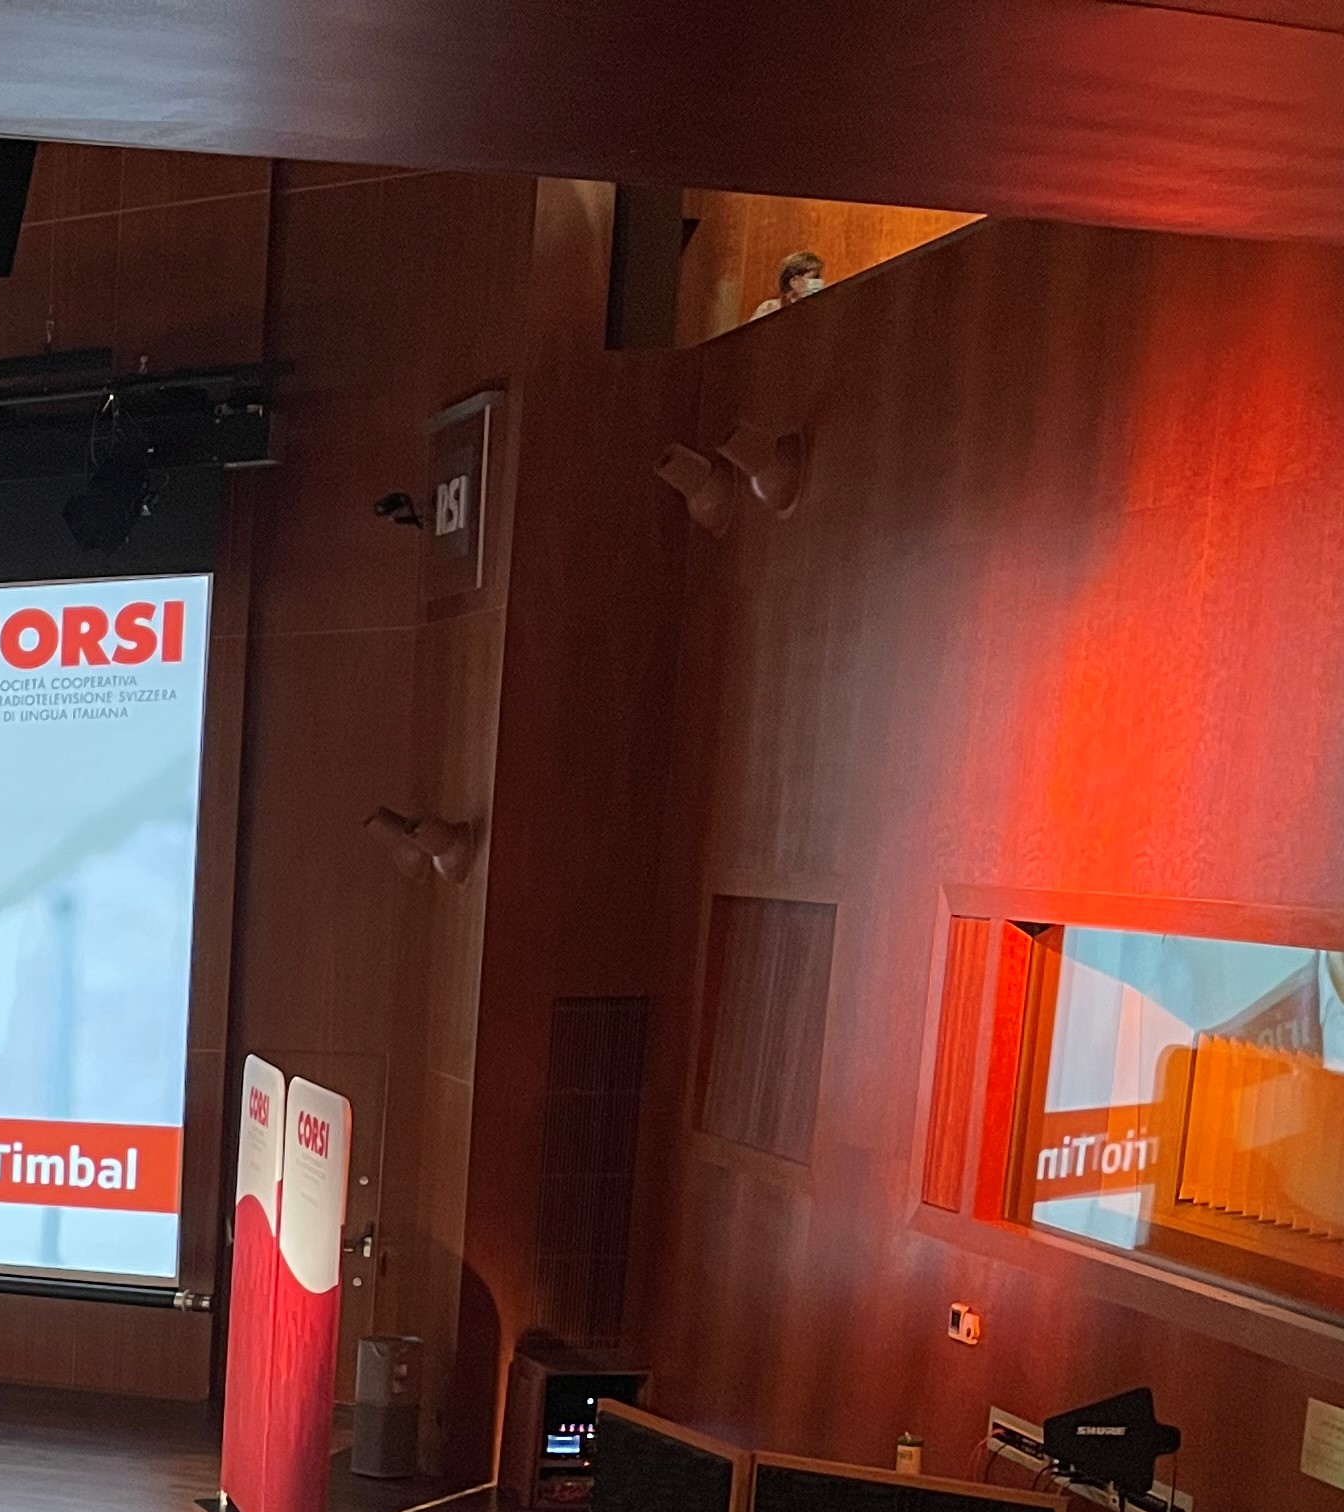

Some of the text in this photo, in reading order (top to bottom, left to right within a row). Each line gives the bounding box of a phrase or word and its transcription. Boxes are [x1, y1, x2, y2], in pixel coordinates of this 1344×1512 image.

[51, 675, 137, 690] COOPERATIVA
[119, 688, 177, 702] SVIZZERA
[3, 706, 128, 722] DI LINGUA ITALIANA
[249, 1086, 269, 1129] CORSI
[297, 1110, 330, 1159] CORSI
